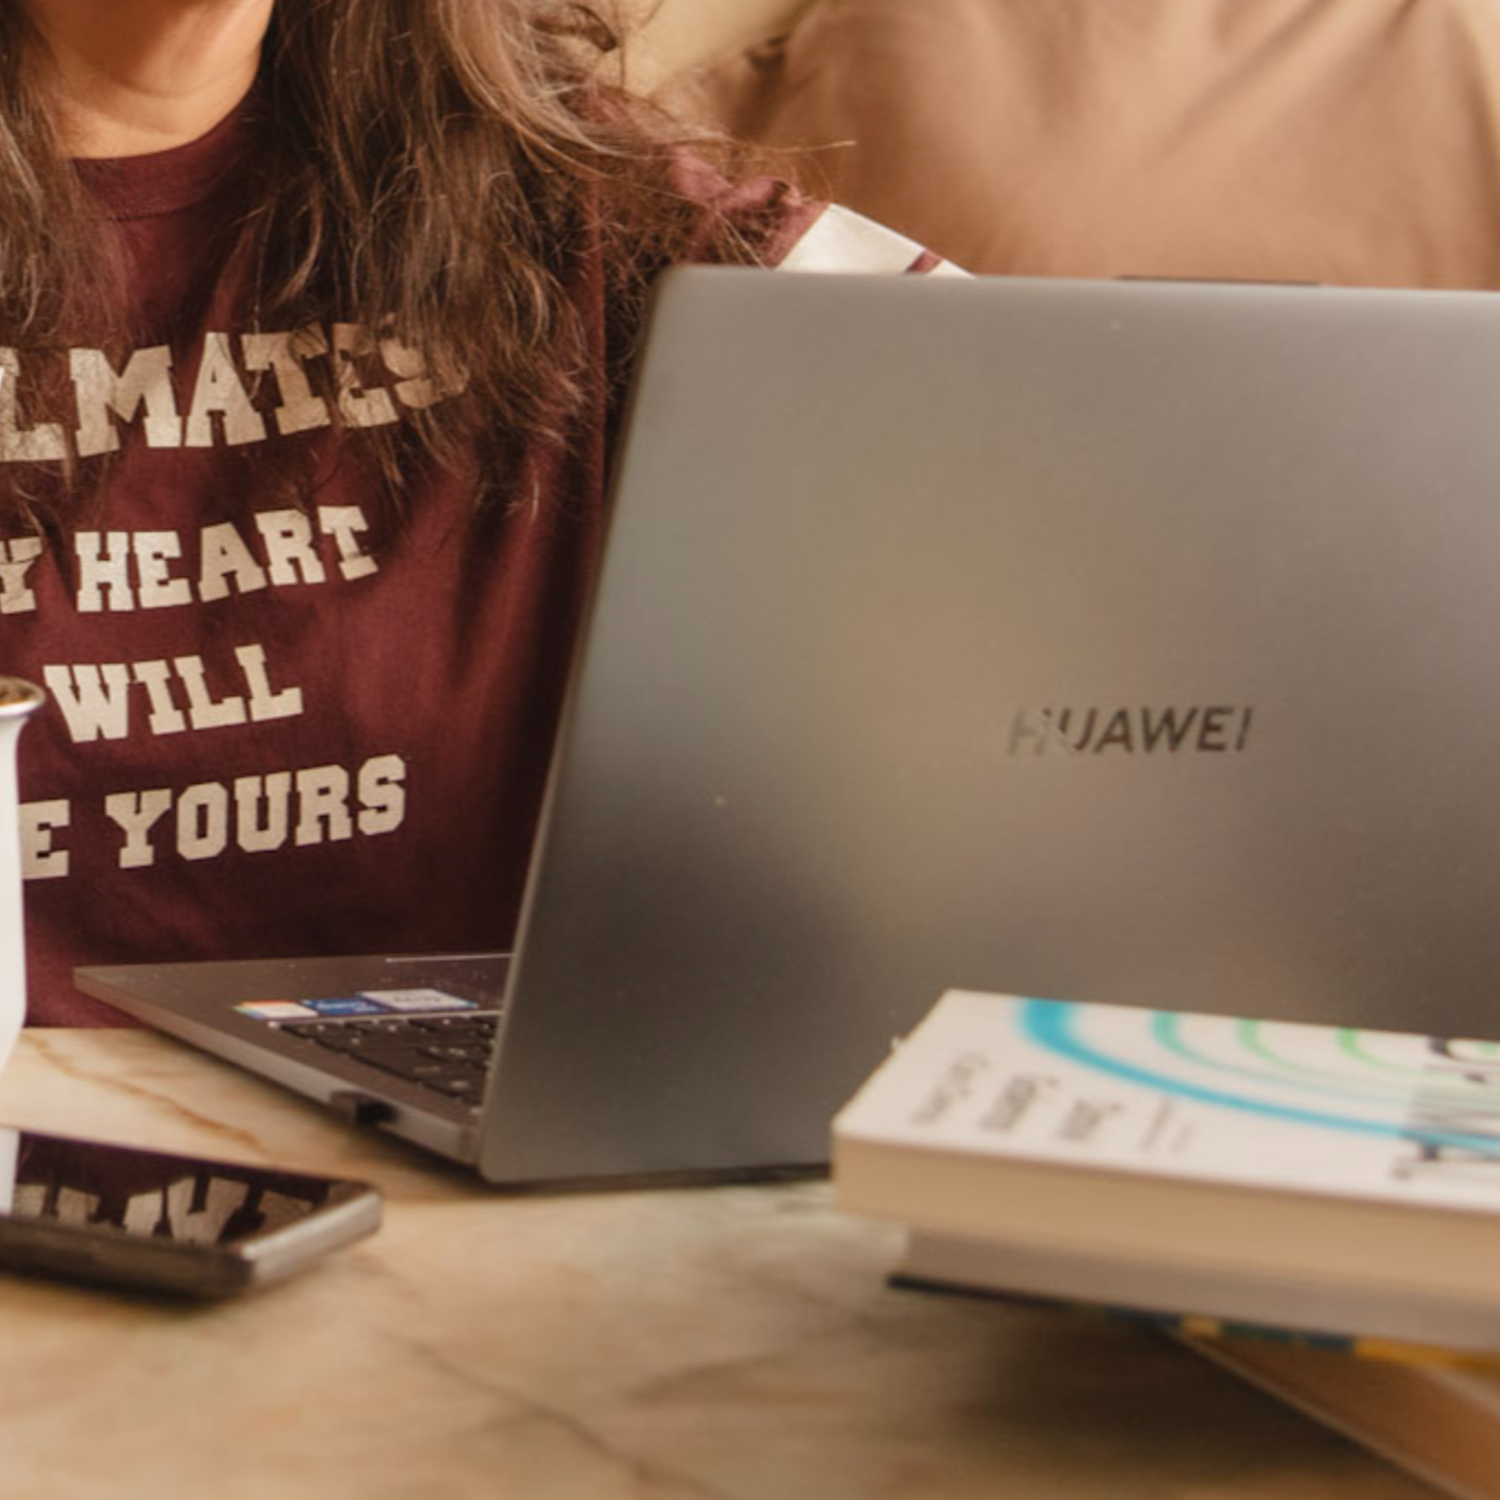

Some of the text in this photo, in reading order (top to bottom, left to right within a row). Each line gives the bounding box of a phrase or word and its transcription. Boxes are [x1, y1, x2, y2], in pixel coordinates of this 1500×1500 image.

[74, 504, 380, 613] HEART
[44, 643, 304, 744] WILL
[1003, 705, 1256, 757] HUAWEI
[104, 753, 407, 870] YOURS
